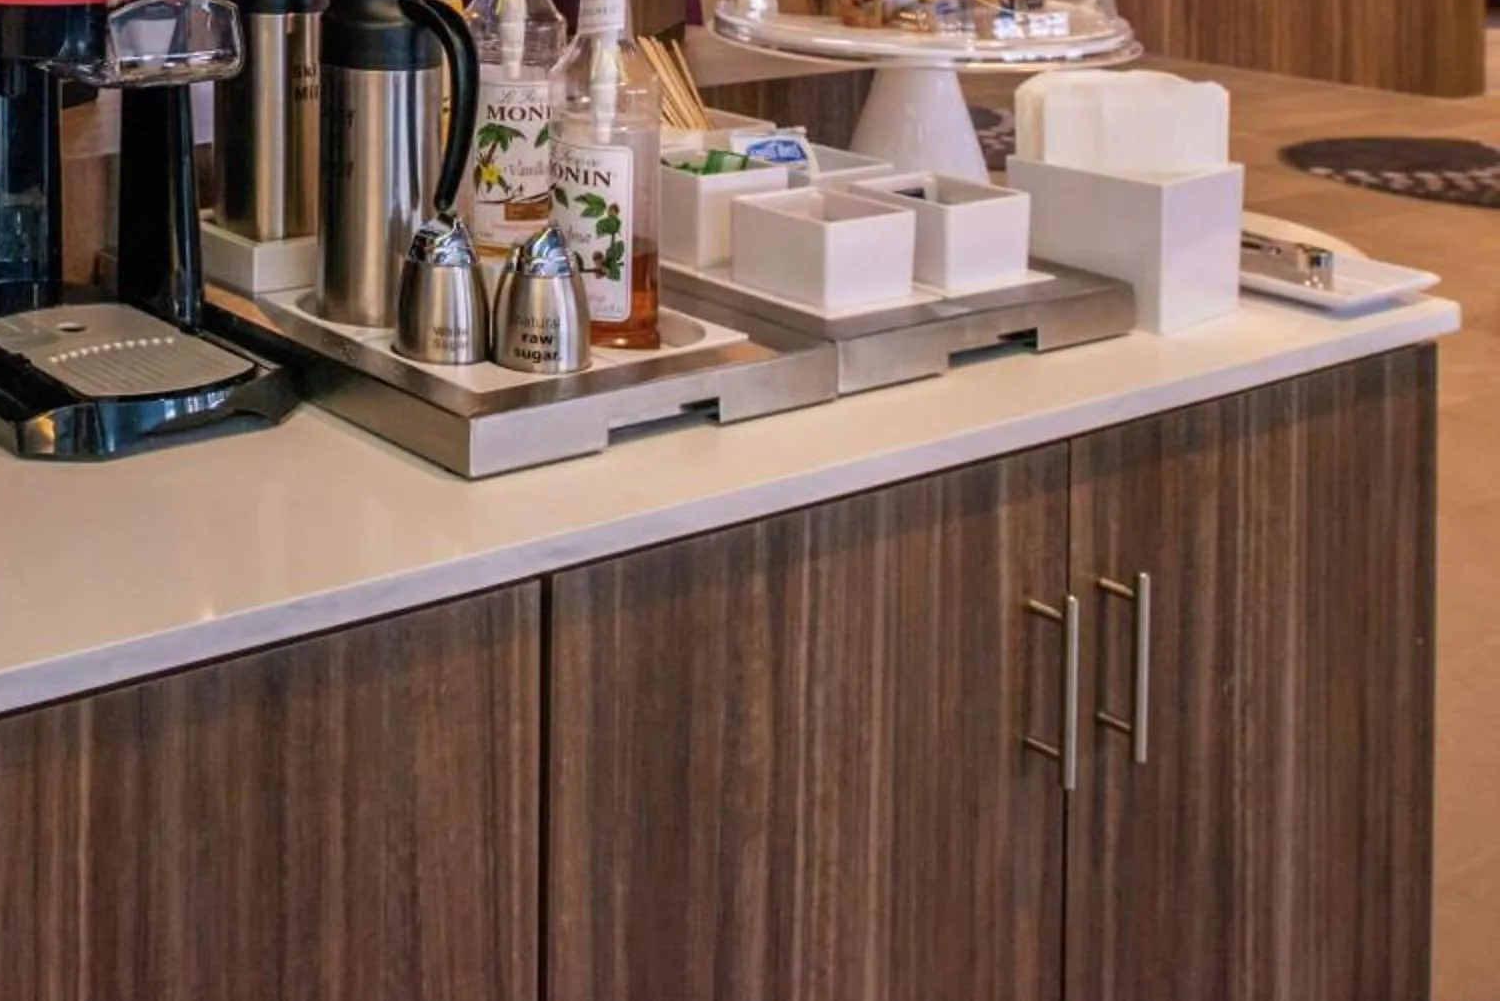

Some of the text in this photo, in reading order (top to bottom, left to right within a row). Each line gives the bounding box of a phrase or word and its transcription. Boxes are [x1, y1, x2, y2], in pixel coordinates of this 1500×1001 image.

[486, 104, 552, 122] MONI
[551, 161, 612, 188] ONIN
[521, 333, 554, 346] raw
